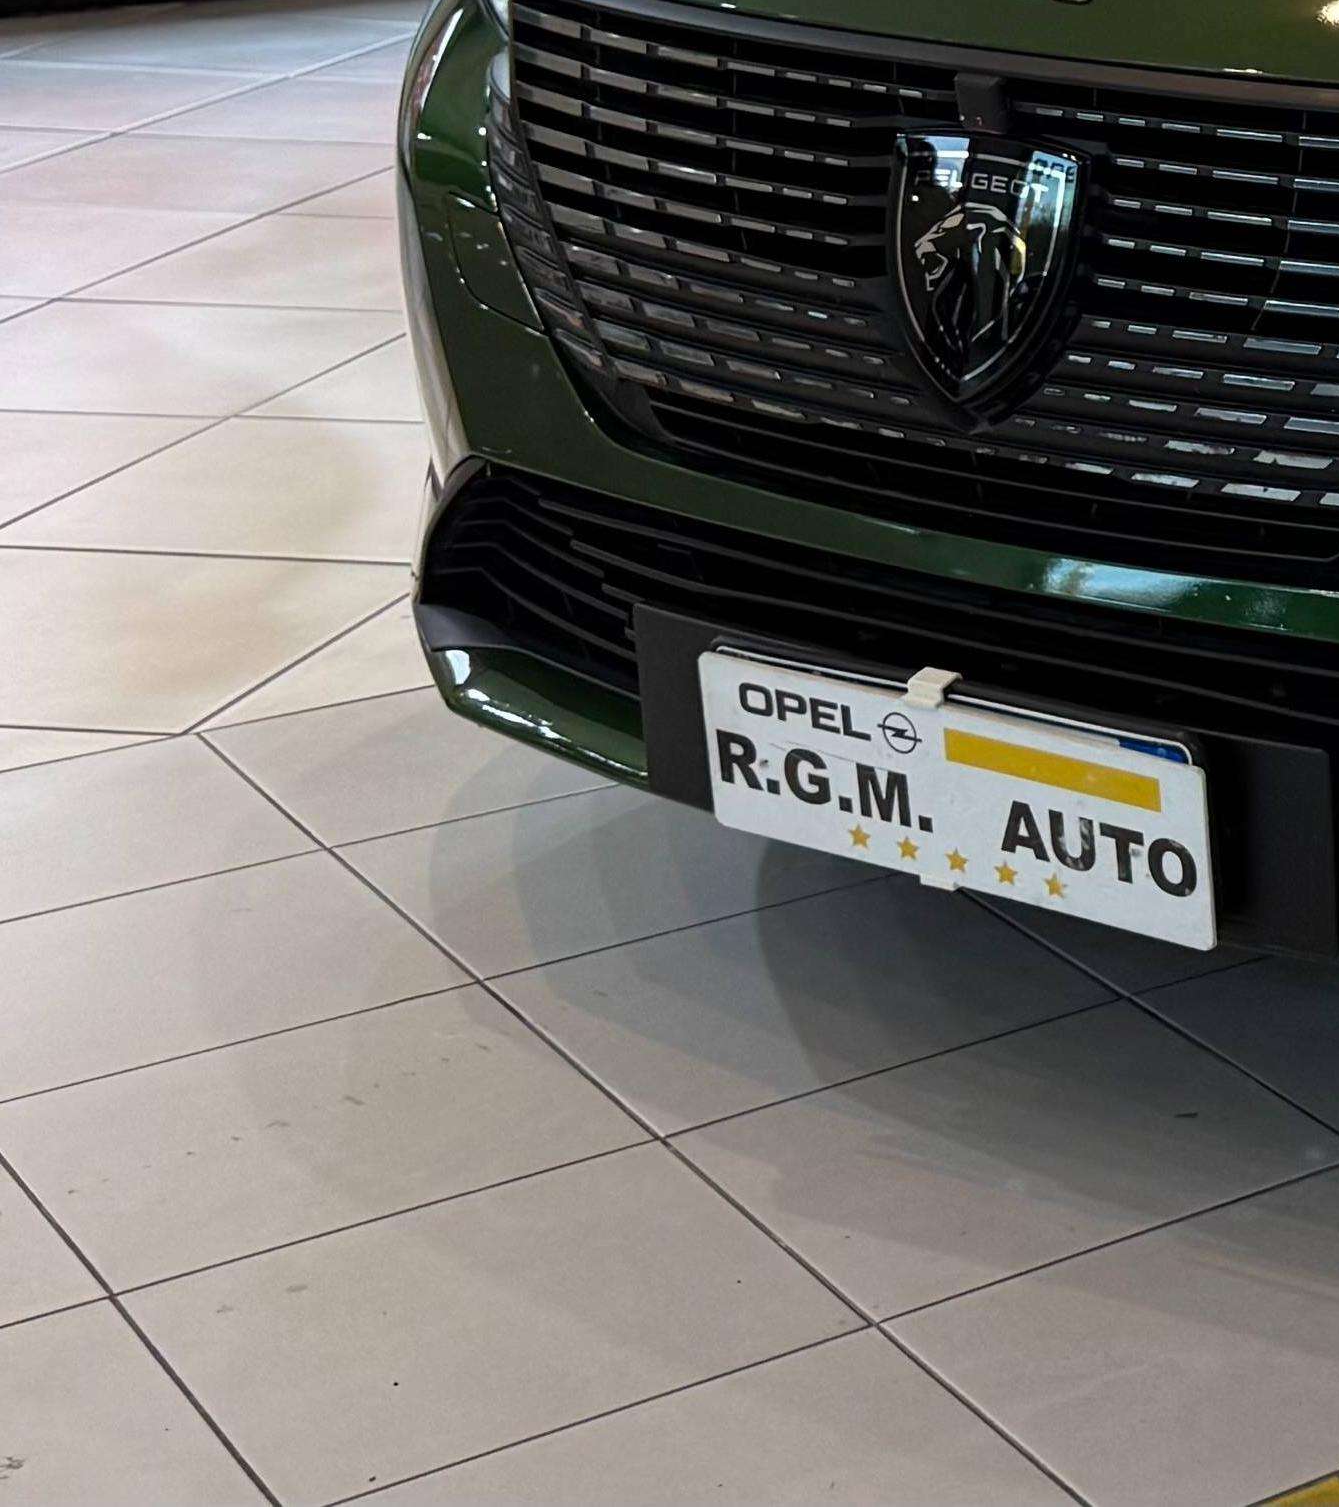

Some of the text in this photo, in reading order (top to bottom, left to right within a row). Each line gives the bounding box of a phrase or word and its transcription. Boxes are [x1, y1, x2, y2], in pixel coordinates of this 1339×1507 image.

[738, 682, 872, 742] OPEL
[715, 728, 1198, 897] R.G.M. AUTO
